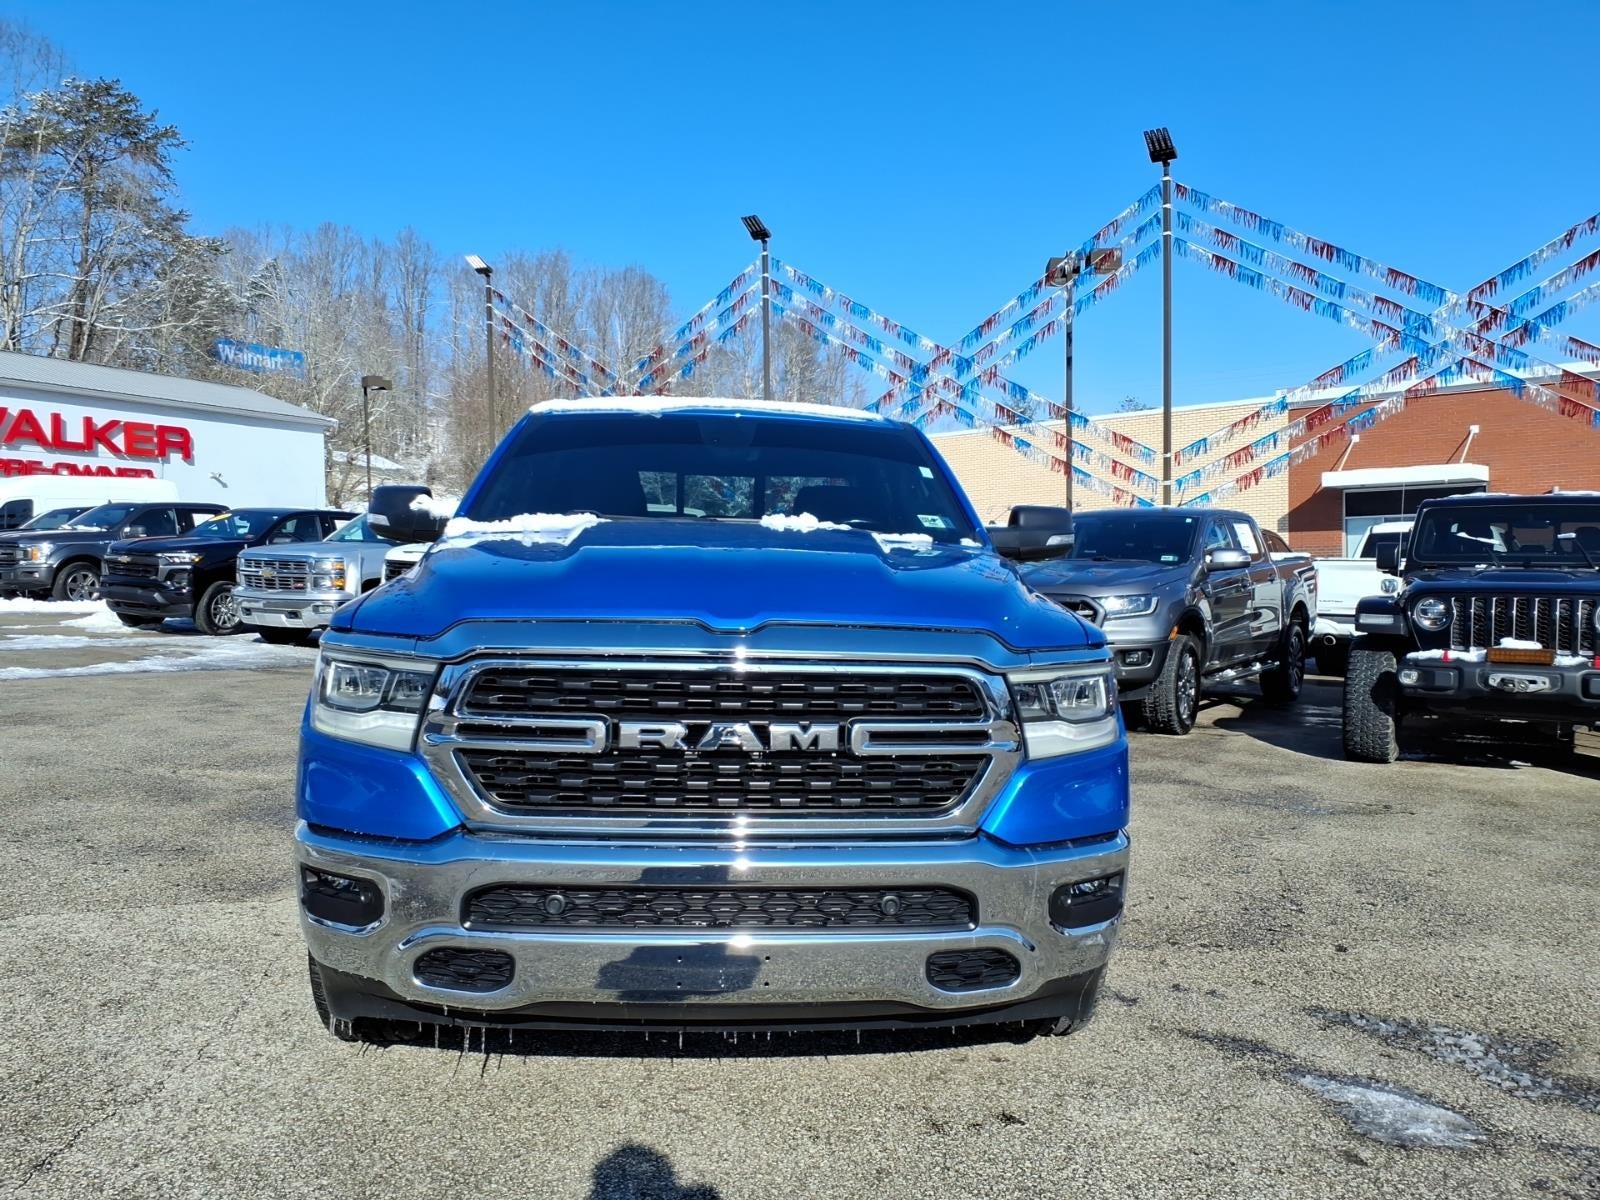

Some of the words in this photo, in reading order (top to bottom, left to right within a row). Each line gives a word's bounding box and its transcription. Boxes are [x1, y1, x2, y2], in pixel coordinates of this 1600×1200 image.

[218, 343, 282, 369] Walmart
[0, 407, 191, 460] ALKER
[619, 721, 840, 751] RAM
